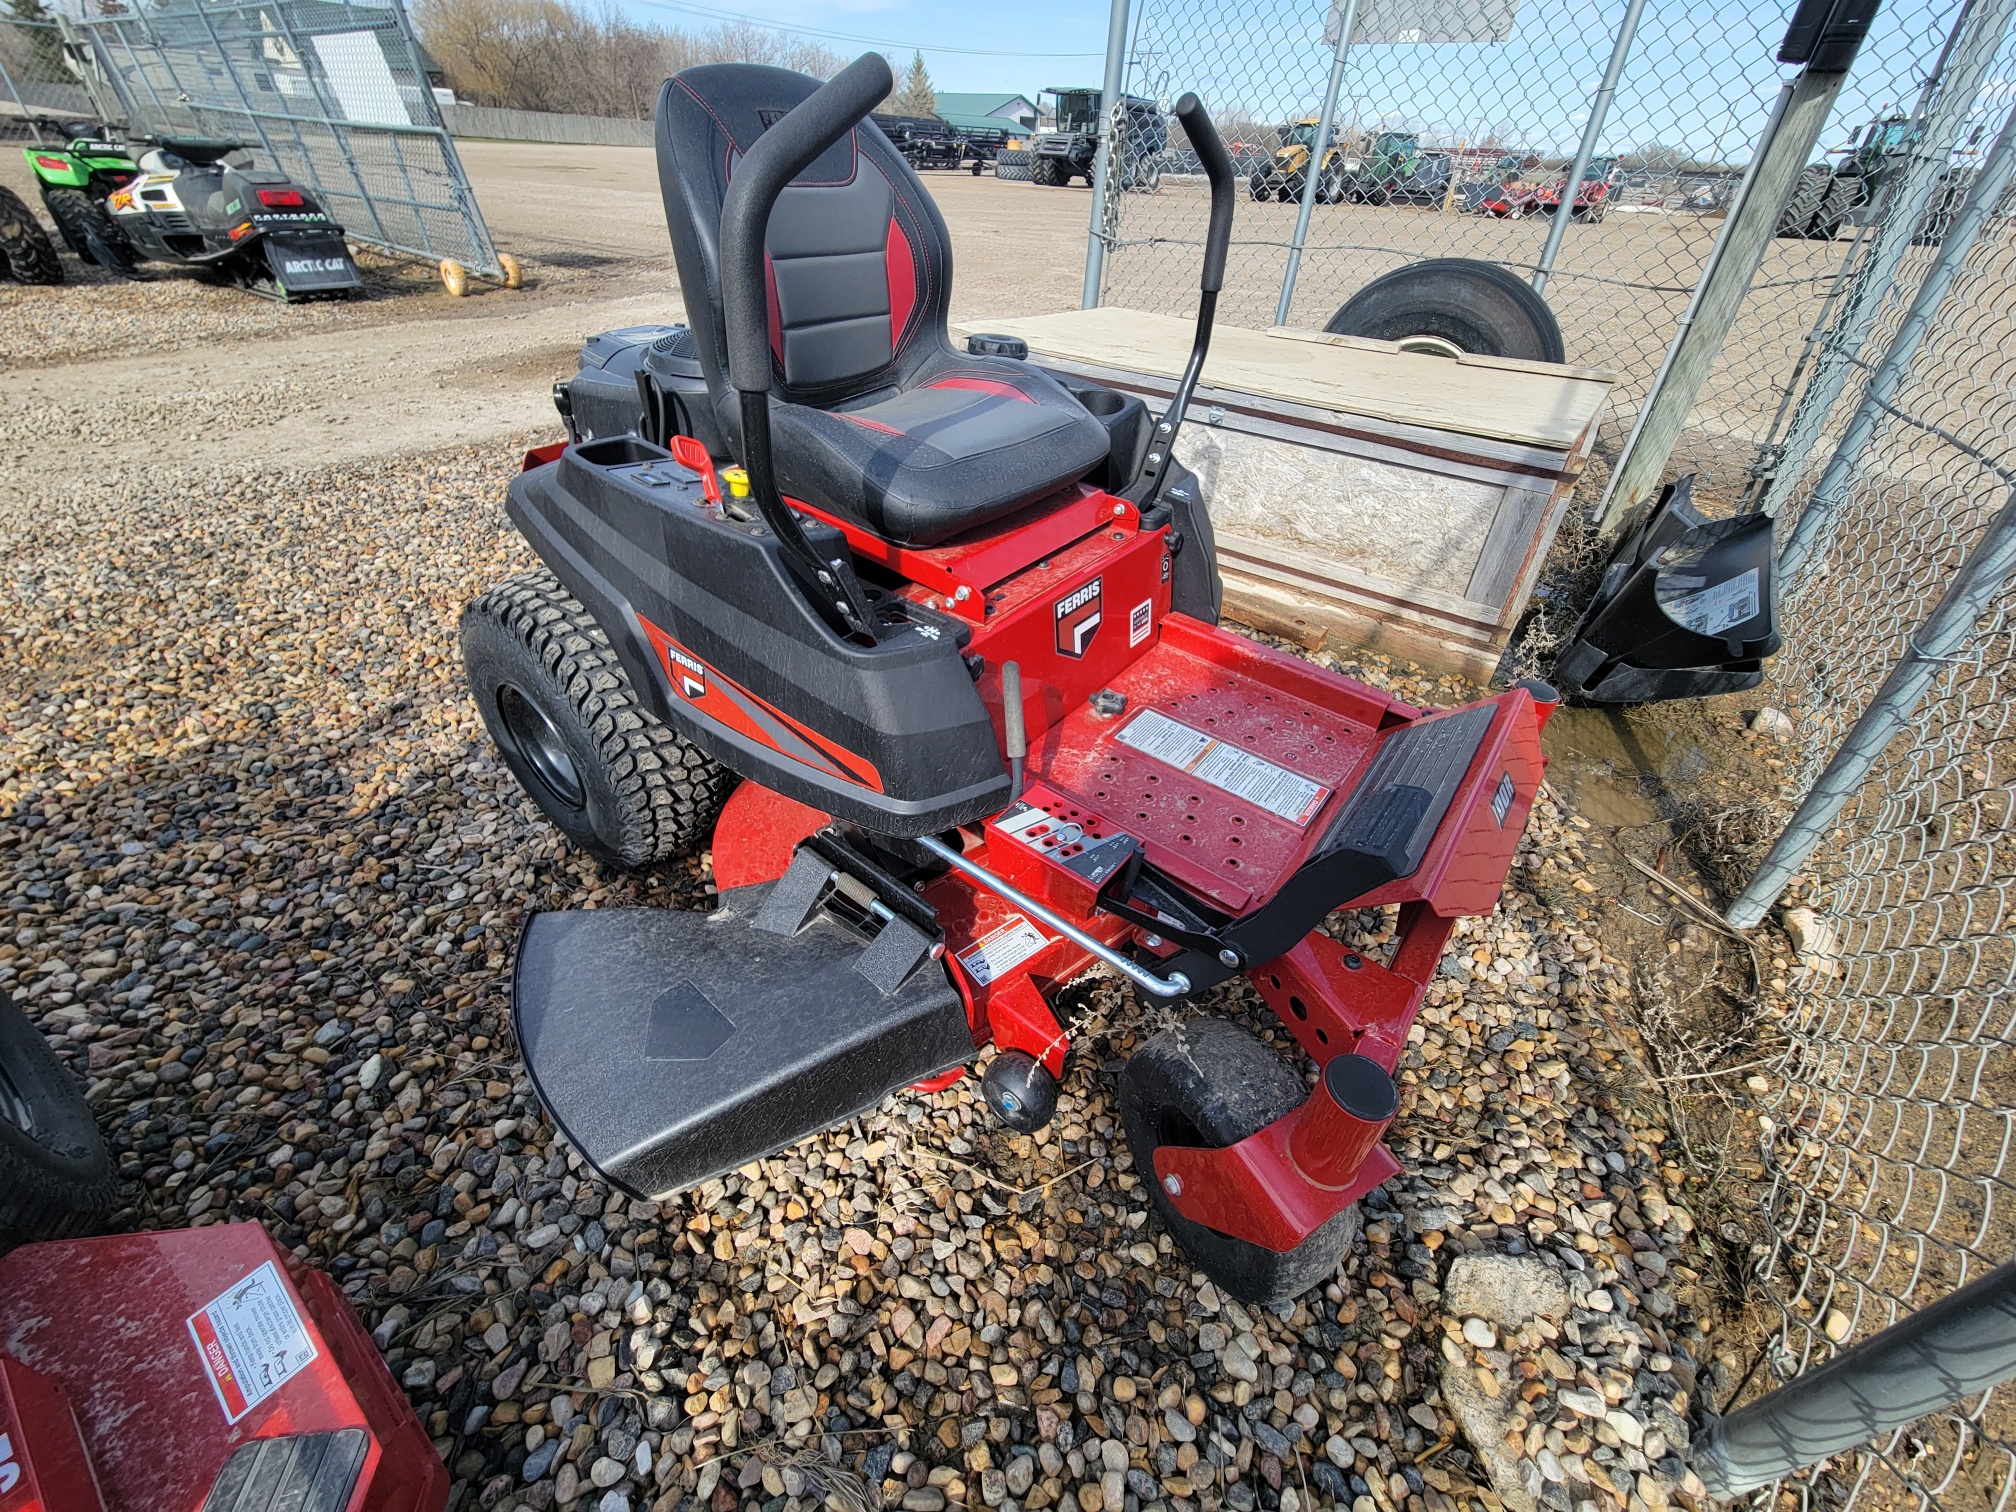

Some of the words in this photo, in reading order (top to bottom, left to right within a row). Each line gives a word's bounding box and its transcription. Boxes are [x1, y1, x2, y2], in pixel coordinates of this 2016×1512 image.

[285, 260, 324, 273] ARCTIC
[325, 258, 344, 271] CAT
[1057, 581, 1100, 619] FERRIS
[670, 649, 703, 675] FERRIS
[1301, 799, 1319, 816] DANGER
[982, 928, 1006, 944] DANGER
[206, 1338, 228, 1377] DANGER
